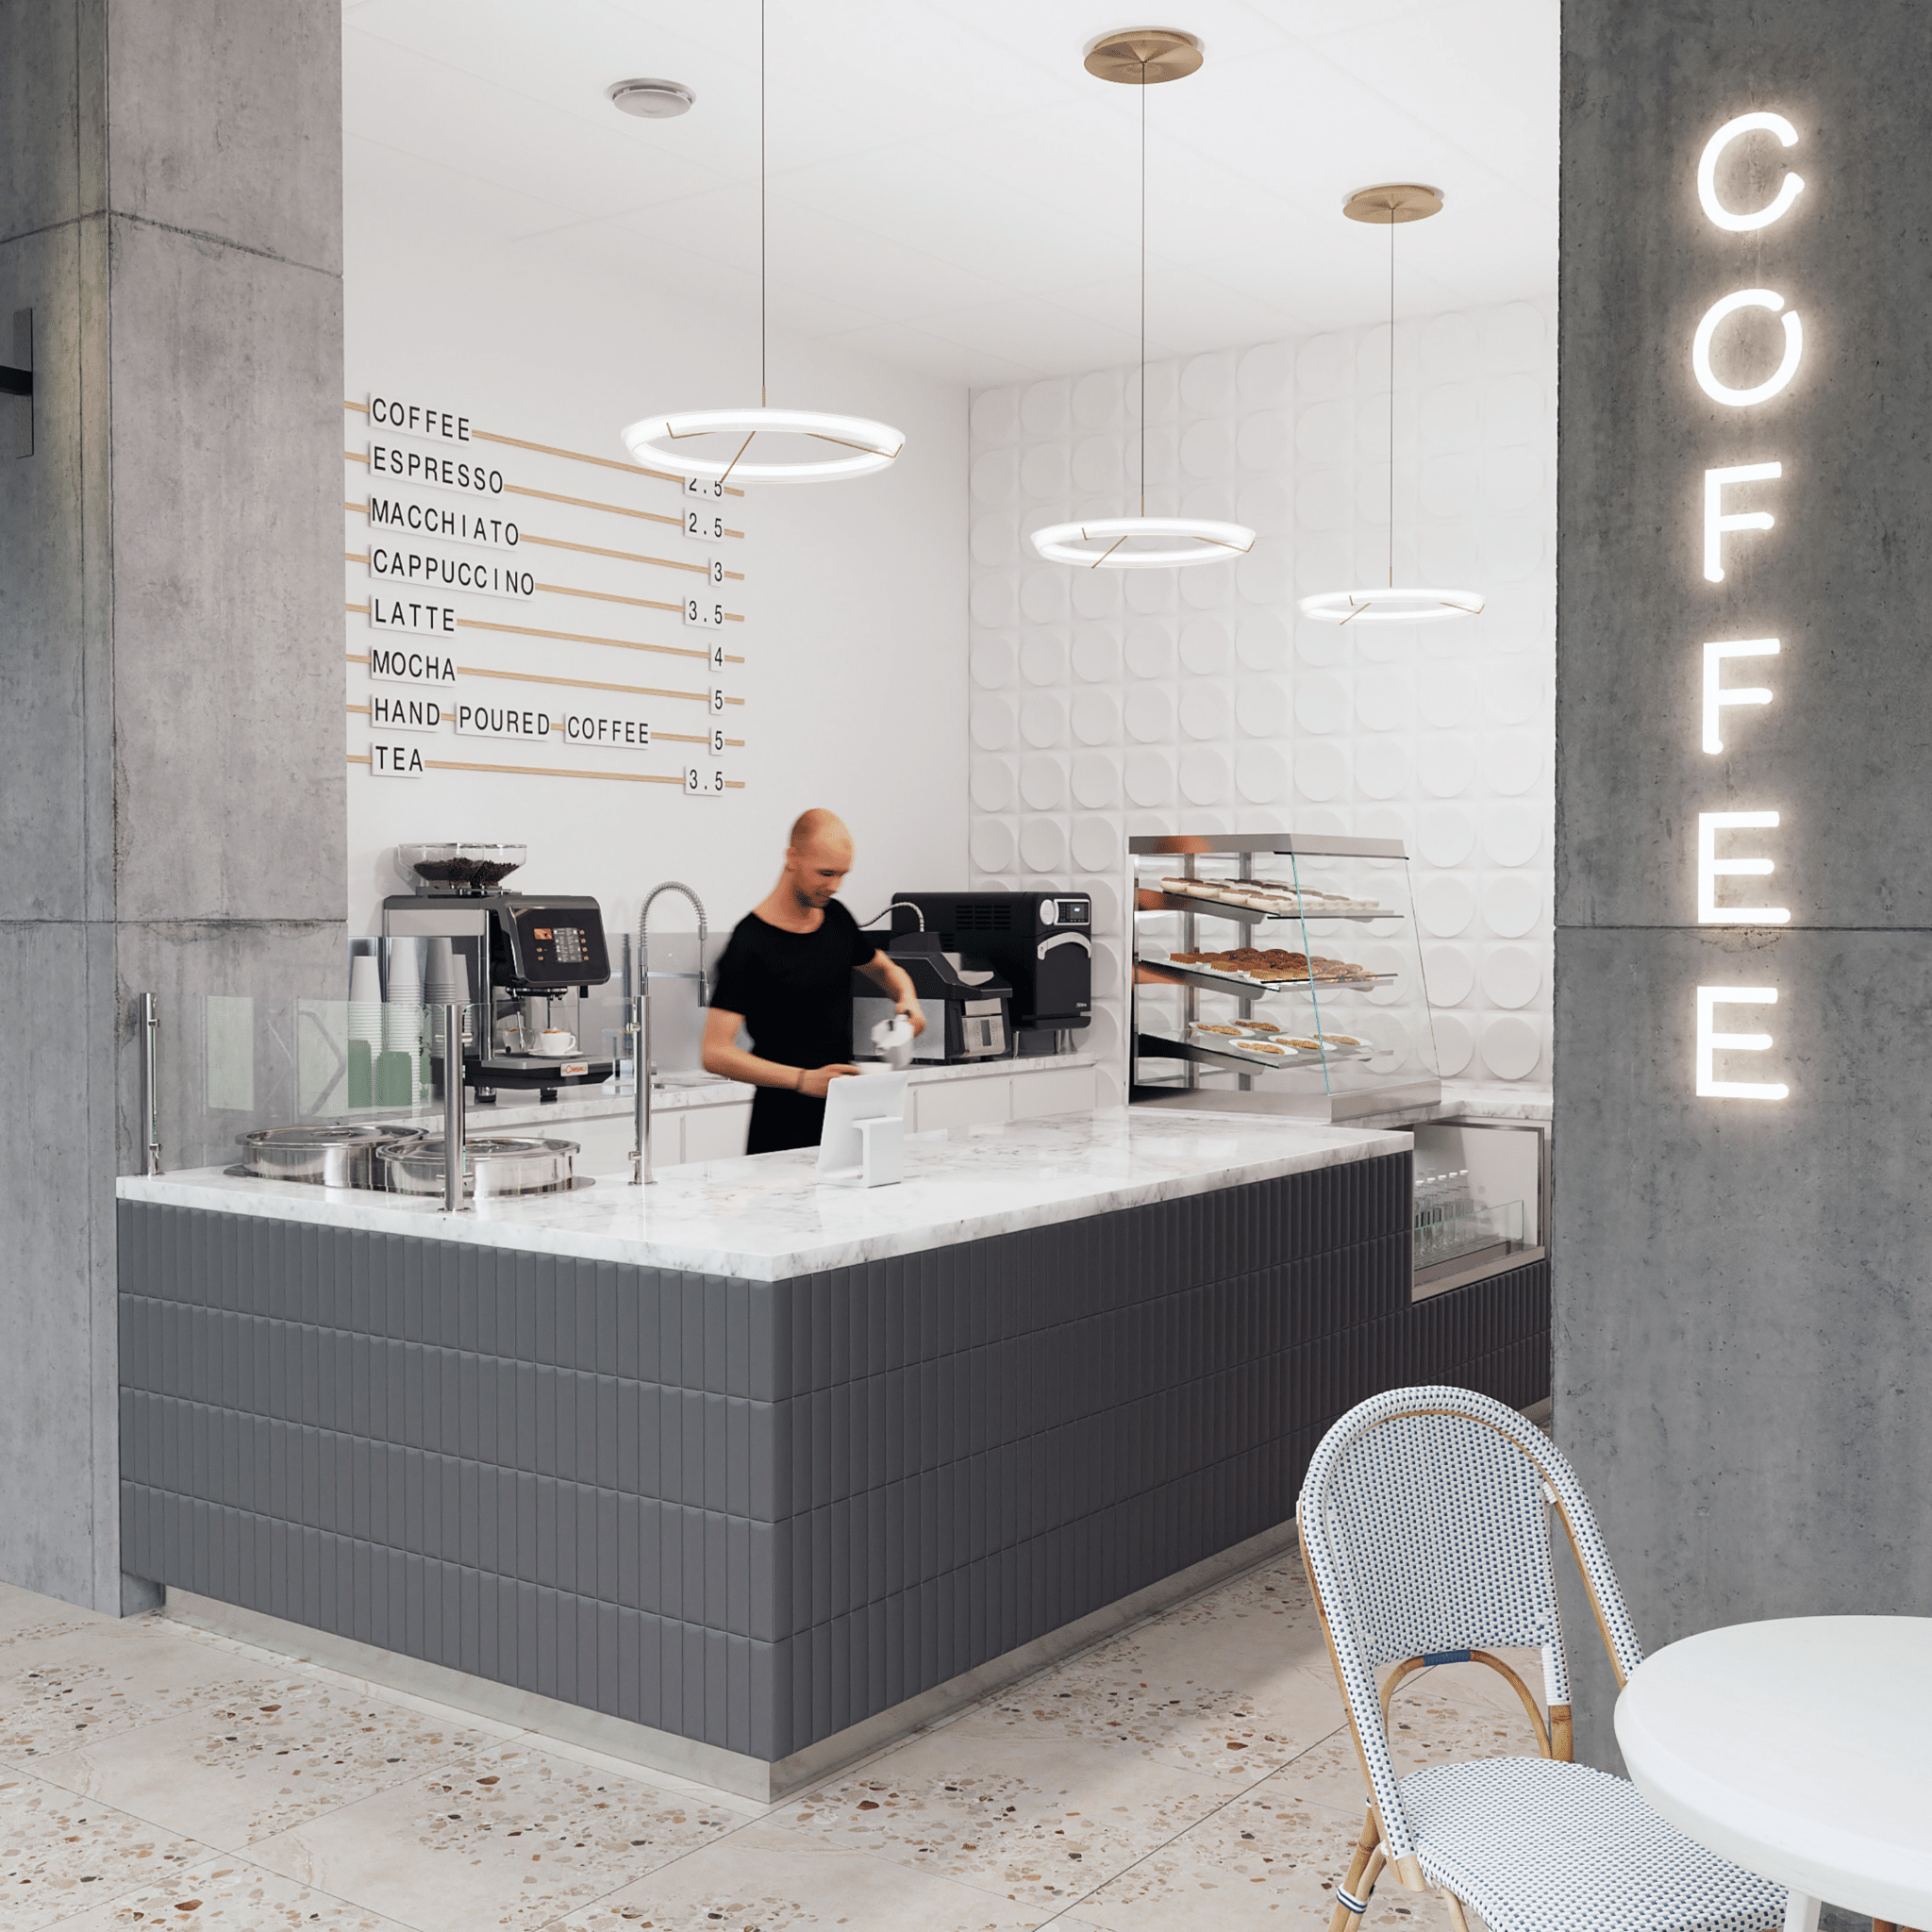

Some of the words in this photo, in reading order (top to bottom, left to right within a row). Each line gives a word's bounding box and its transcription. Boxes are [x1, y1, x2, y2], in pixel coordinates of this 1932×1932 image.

[372, 398, 470, 441] COFFEE
[689, 477, 723, 497] 2.5
[374, 445, 503, 494] ESPRESSO
[689, 512, 723, 538] 2.5
[372, 497, 519, 546] MACCHIATO
[714, 561, 723, 582] 3
[373, 548, 534, 595] CAPPUCCINO
[689, 600, 723, 625] 3.5
[1691, 110, 1806, 1102] COFFEE
[375, 598, 455, 632] LATTE
[714, 647, 723, 666] 4
[373, 649, 456, 681] MOCHA
[714, 690, 723, 710] 5
[375, 697, 441, 726] HAND
[459, 706, 550, 735] POURED
[568, 716, 649, 744] COFFEE
[715, 730, 724, 751] 5
[375, 745, 424, 772] TEA
[689, 769, 724, 791] 3.5
